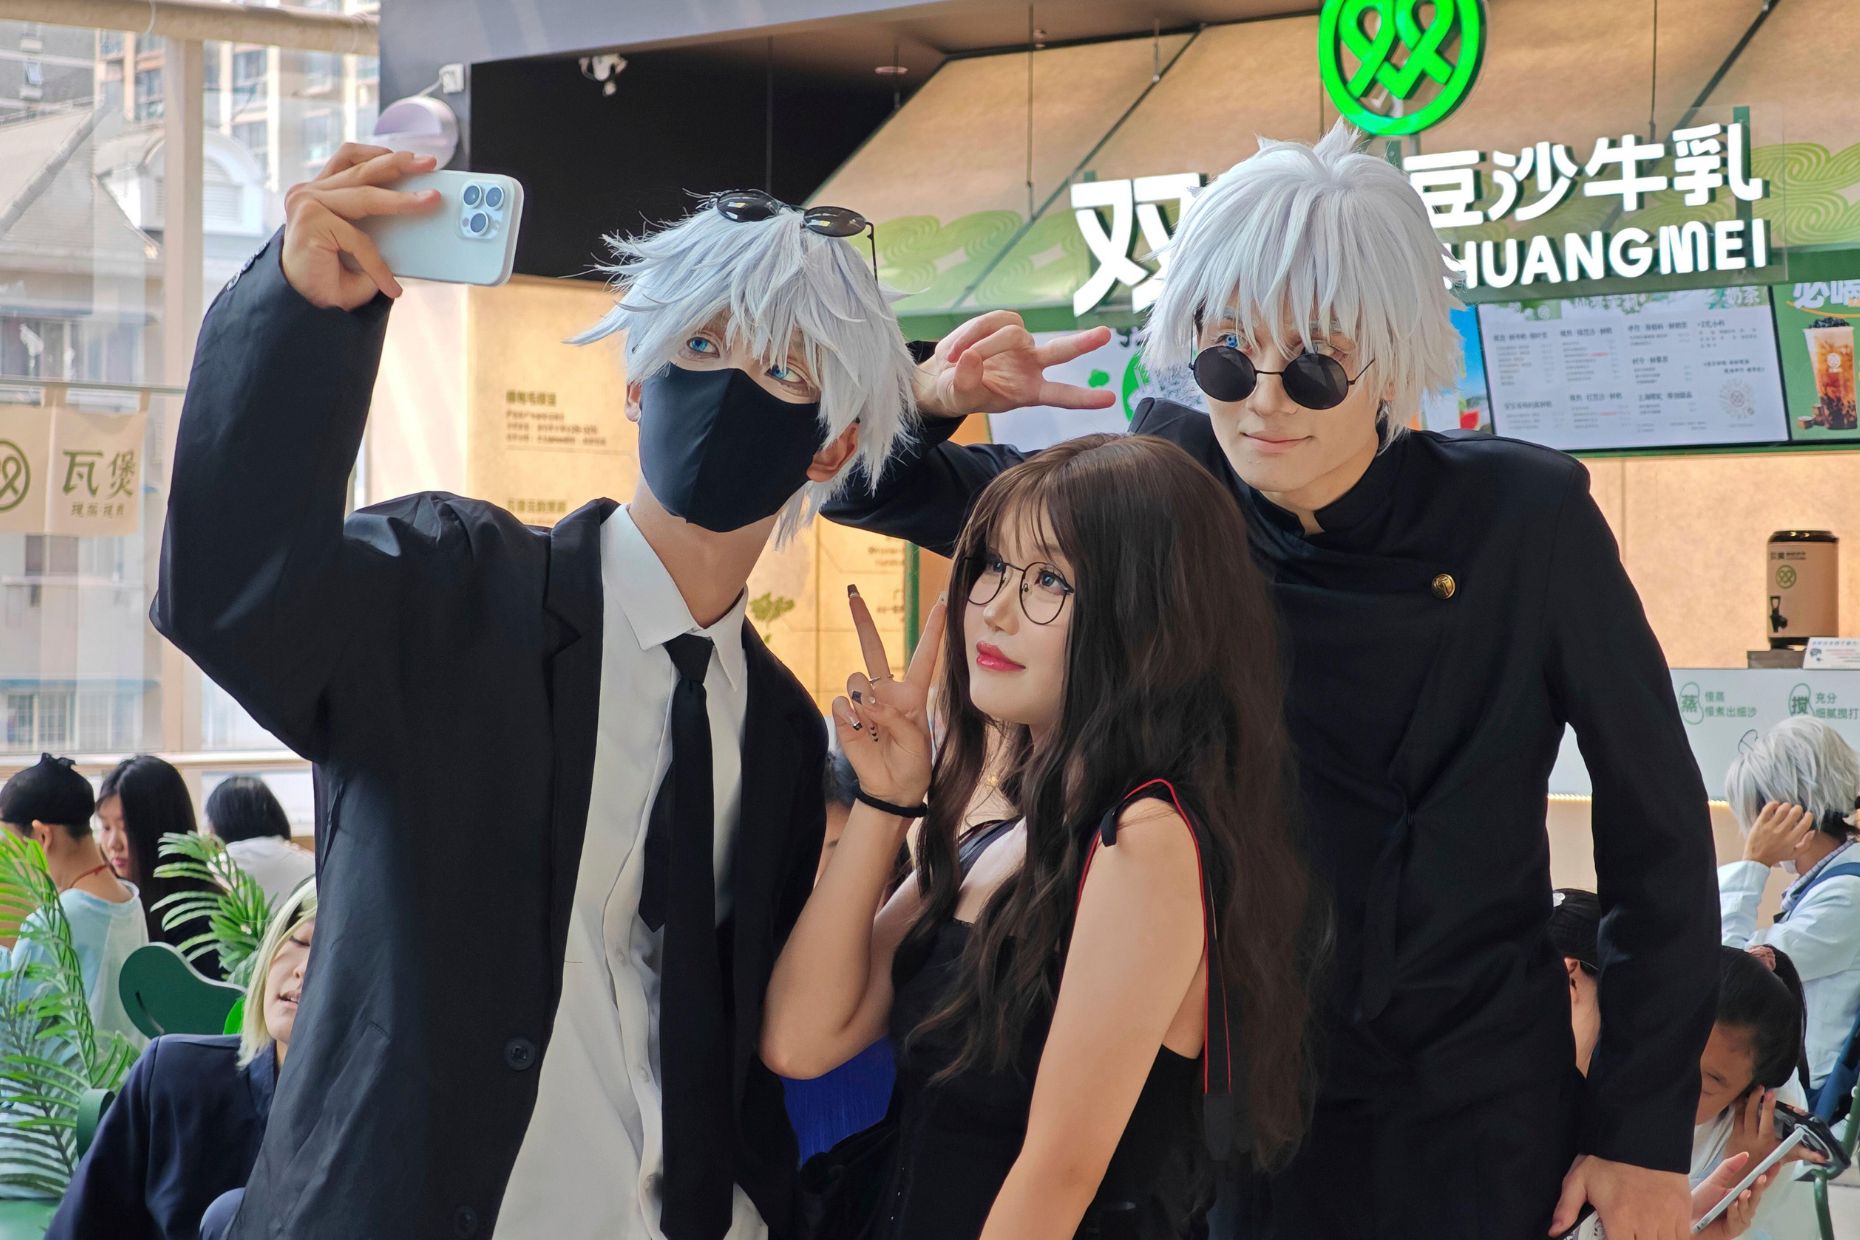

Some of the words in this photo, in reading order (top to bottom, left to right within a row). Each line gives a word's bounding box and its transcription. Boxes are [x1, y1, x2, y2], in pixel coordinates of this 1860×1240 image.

[1403, 122, 1763, 229] 豆沙牛乳
[62, 448, 137, 500] 瓦煲
[1815, 692, 1837, 704] 充分
